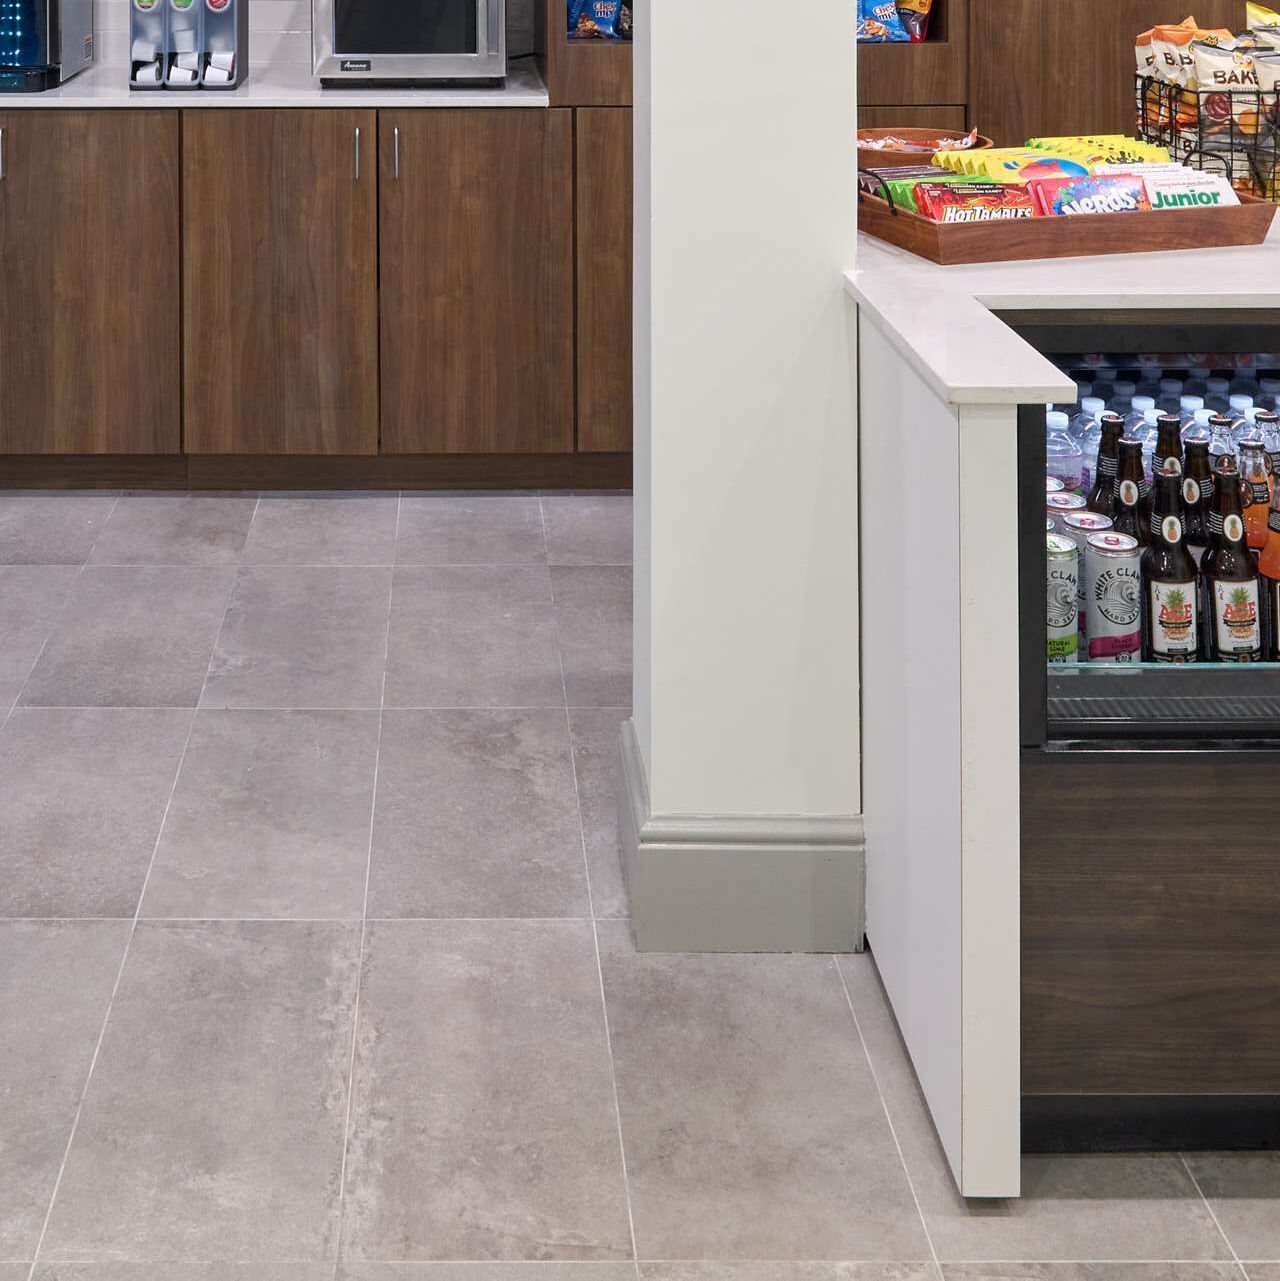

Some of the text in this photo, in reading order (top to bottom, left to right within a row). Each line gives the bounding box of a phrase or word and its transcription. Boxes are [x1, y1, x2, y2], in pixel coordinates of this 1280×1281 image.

[1152, 189, 1220, 209] Junior
[943, 206, 974, 223] HOT
[1095, 570, 1115, 601] WHITE
